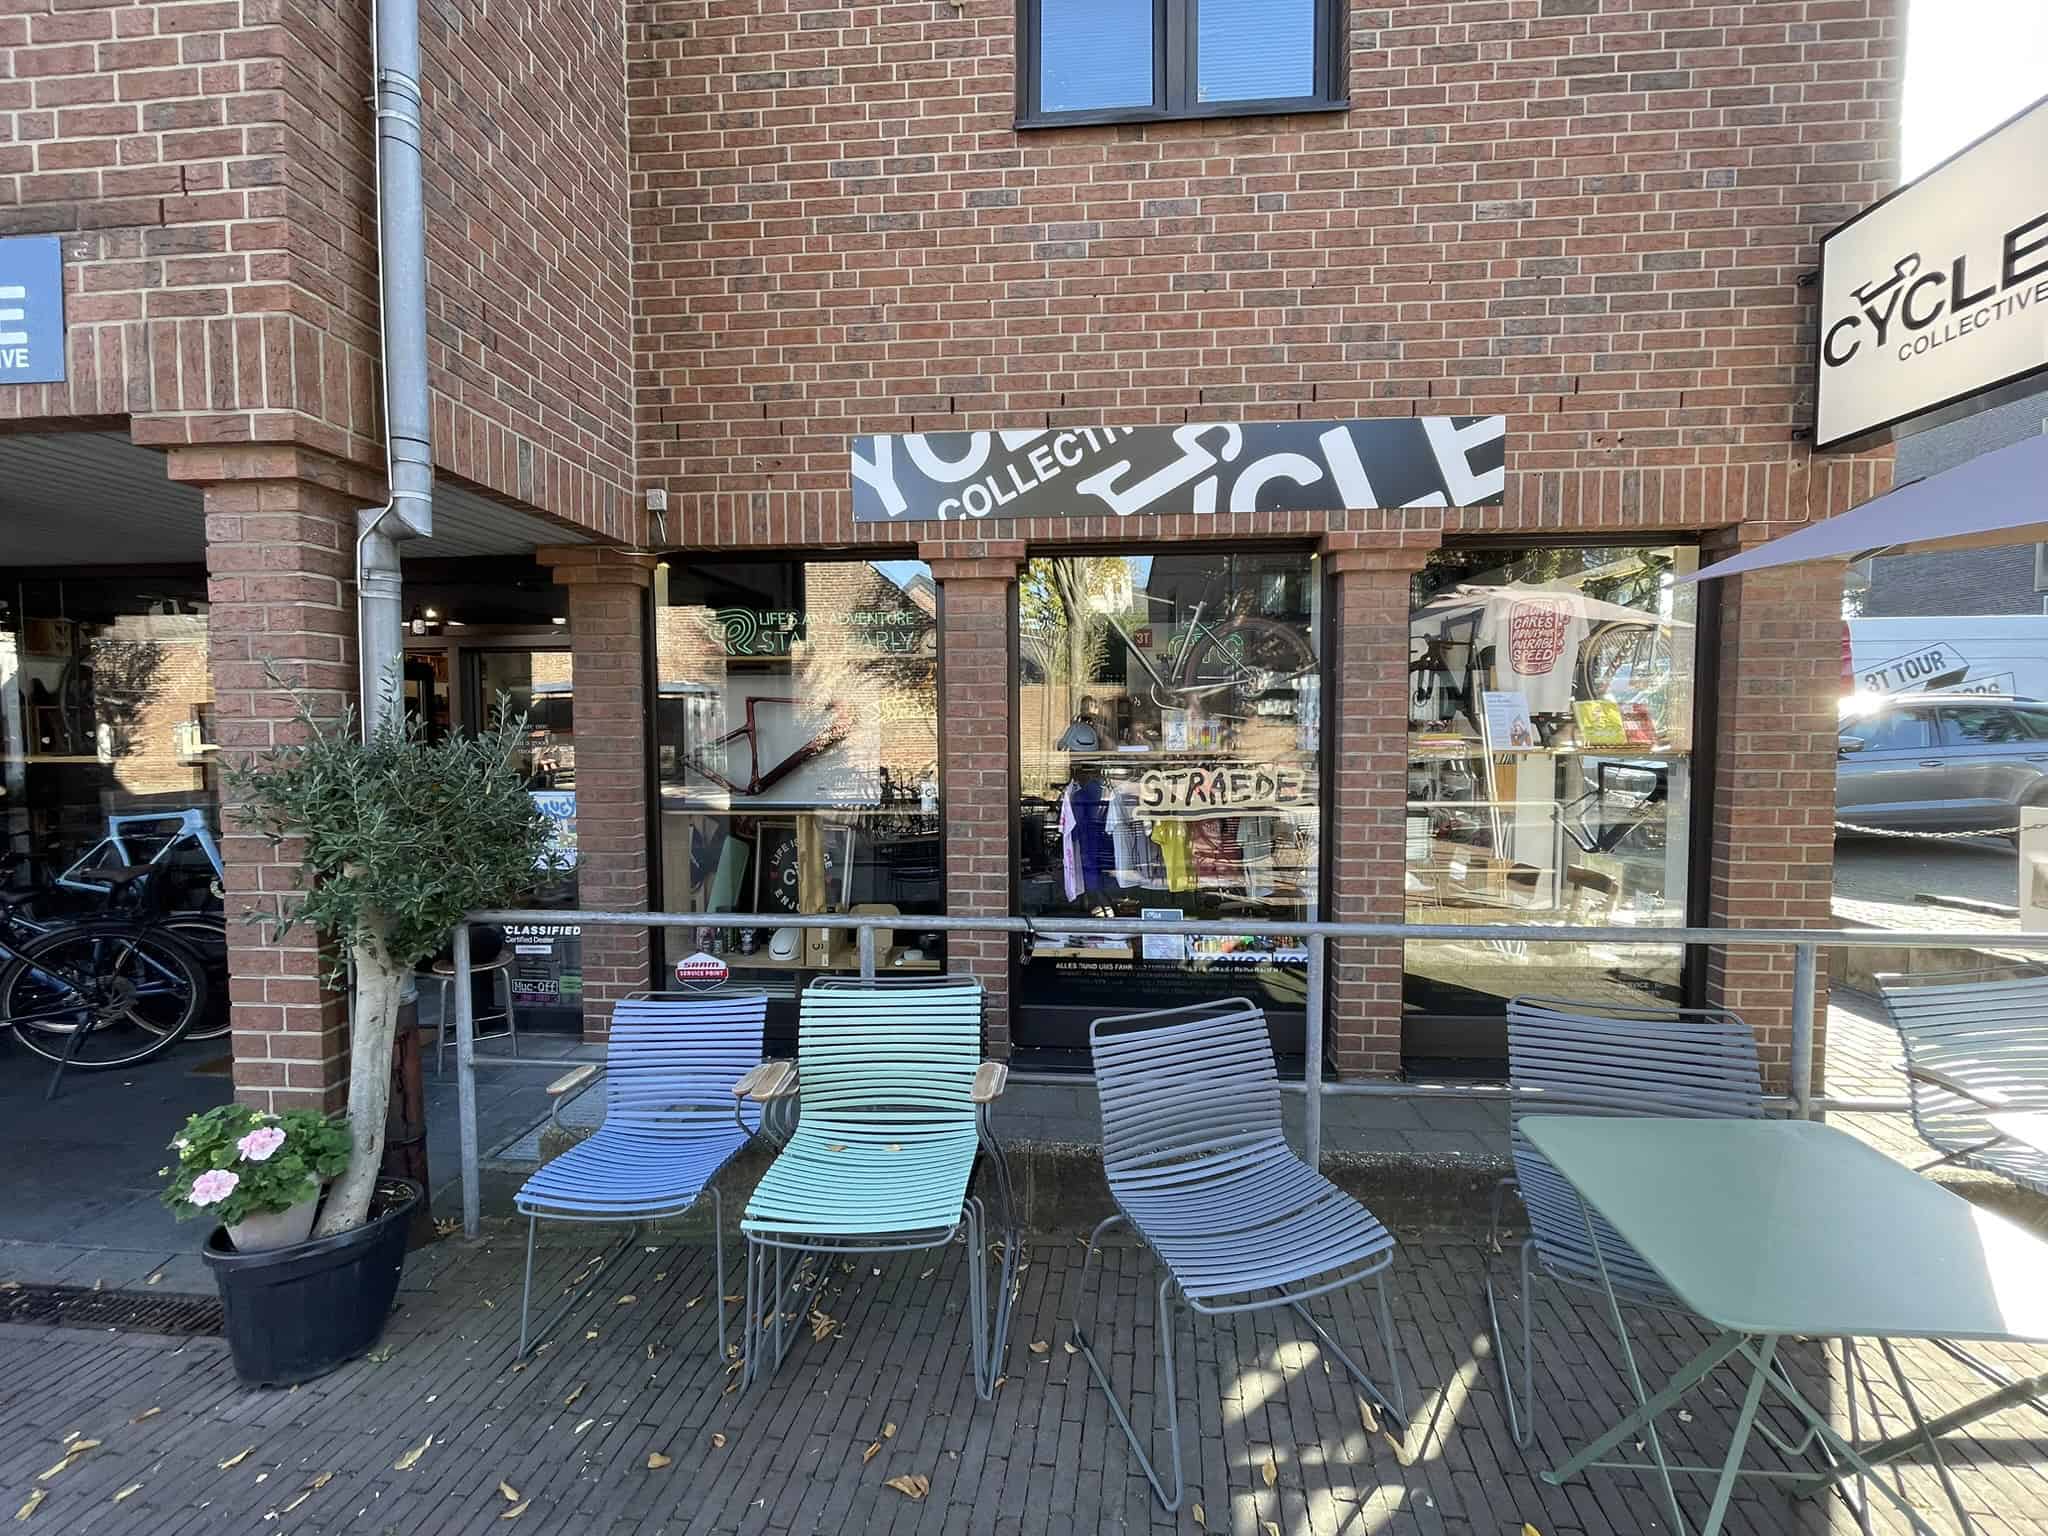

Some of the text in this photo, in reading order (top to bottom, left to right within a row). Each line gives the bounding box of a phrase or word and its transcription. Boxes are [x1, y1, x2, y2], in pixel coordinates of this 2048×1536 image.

[1823, 212, 2048, 368] CYCLE
[1899, 280, 2048, 362] COLLECTIVE
[759, 612, 798, 626] LIFE'S
[831, 611, 915, 626] ADVENTURE
[761, 631, 915, 653] STAR ARLY
[1513, 648, 1554, 661] SPEED
[1891, 650, 1946, 683] TOUR
[503, 925, 582, 936] CLASSIFIED
[513, 981, 557, 993] Muc-Off
